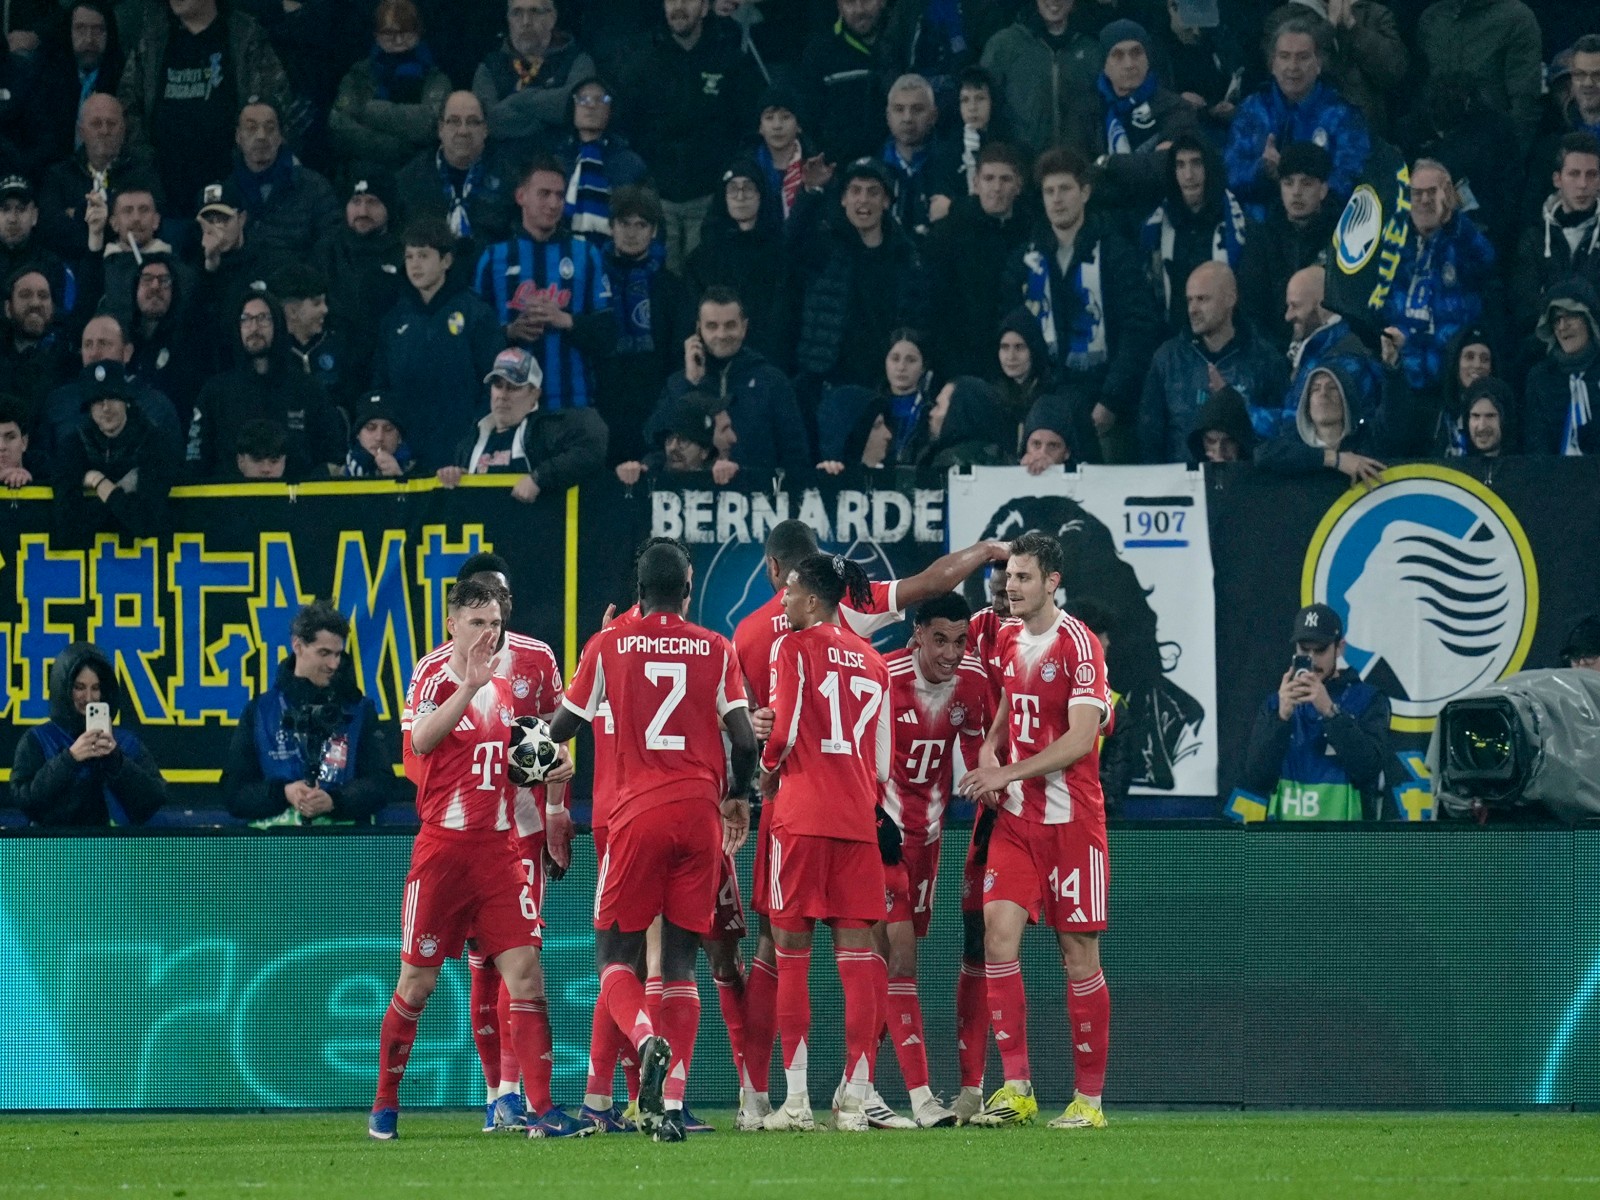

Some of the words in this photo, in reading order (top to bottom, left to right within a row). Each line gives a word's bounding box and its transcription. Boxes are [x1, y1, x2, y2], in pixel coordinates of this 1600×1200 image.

[651, 488, 944, 542] BERNARDE
[1123, 511, 1186, 536] 1907
[771, 613, 791, 632] TA
[617, 636, 710, 655] UPAMECANO
[828, 647, 866, 670] OLISE
[645, 661, 686, 750] 2
[818, 671, 882, 759] 17
[1283, 788, 1319, 817] HB
[519, 884, 537, 920] 6
